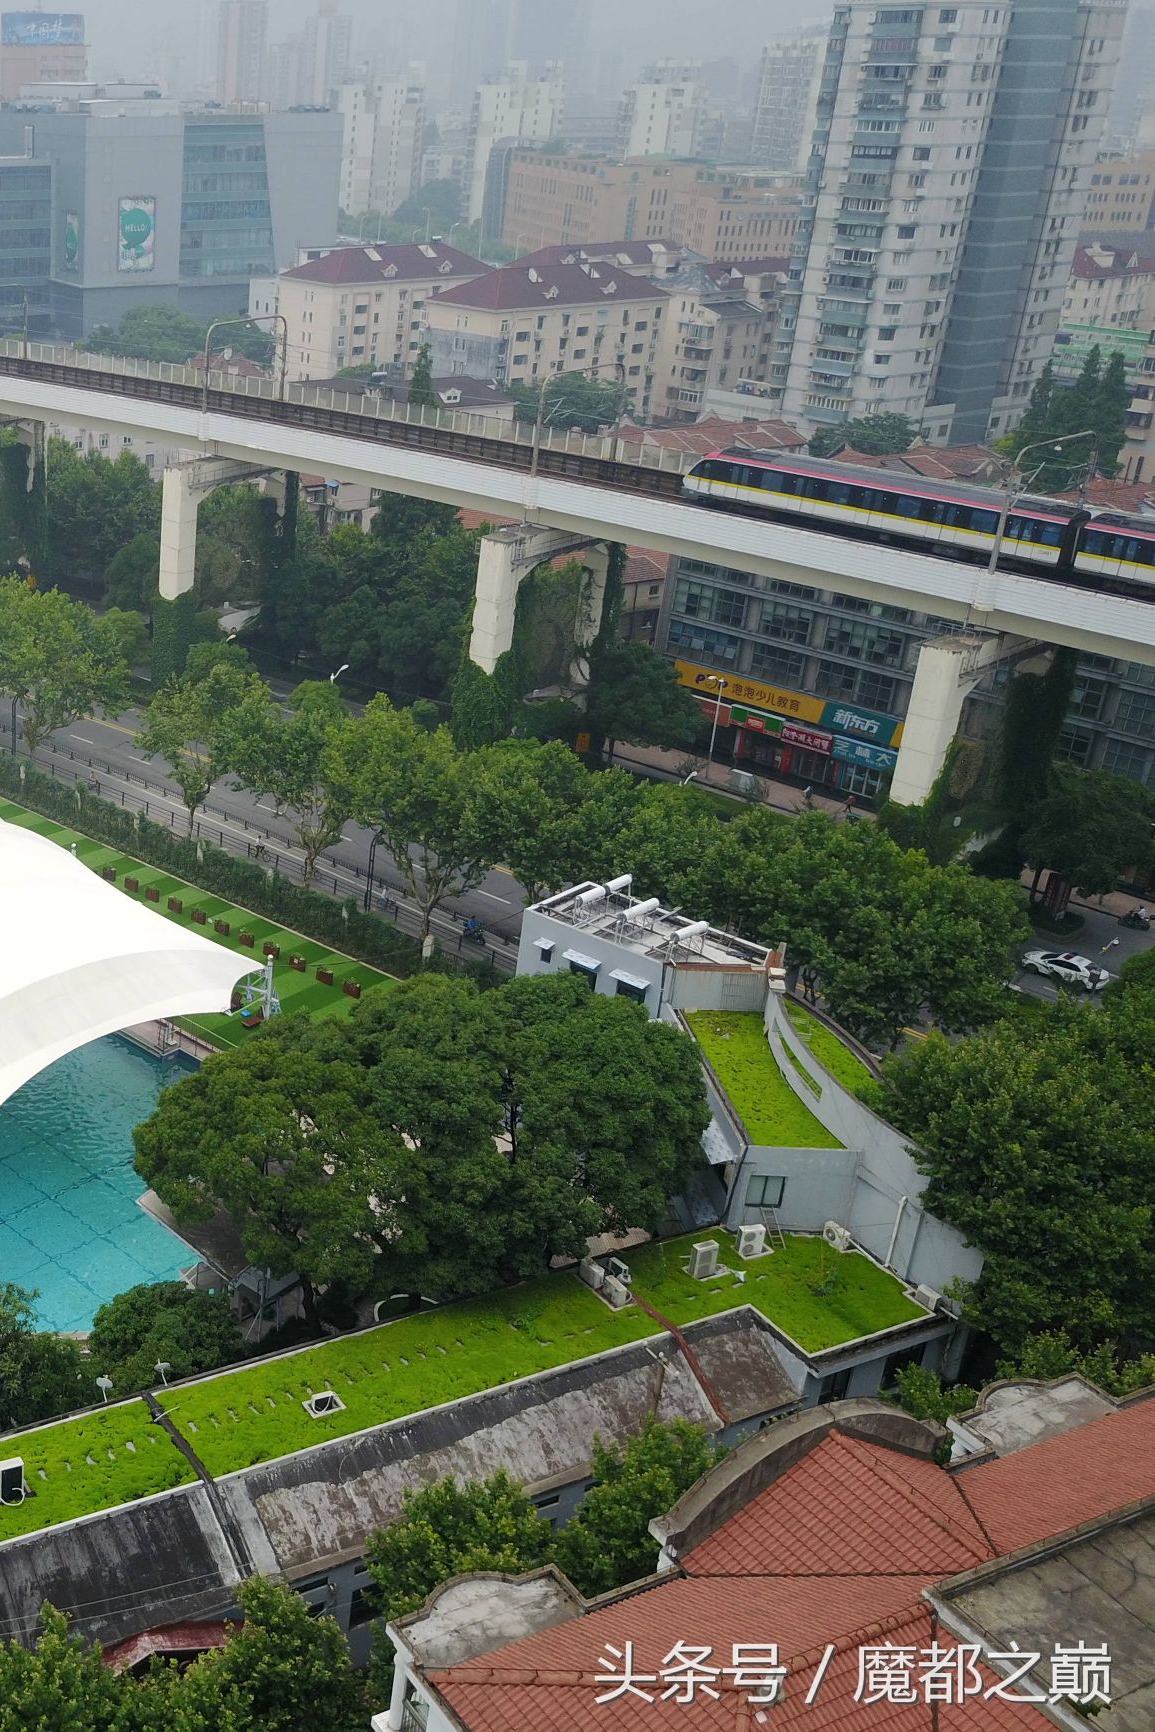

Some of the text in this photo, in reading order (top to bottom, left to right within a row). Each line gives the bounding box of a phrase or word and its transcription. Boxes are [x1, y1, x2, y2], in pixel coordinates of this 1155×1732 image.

[125, 223, 146, 233] HELLO
[732, 683, 800, 712] 泡泡少儿教育
[832, 709, 881, 733] 新东方
